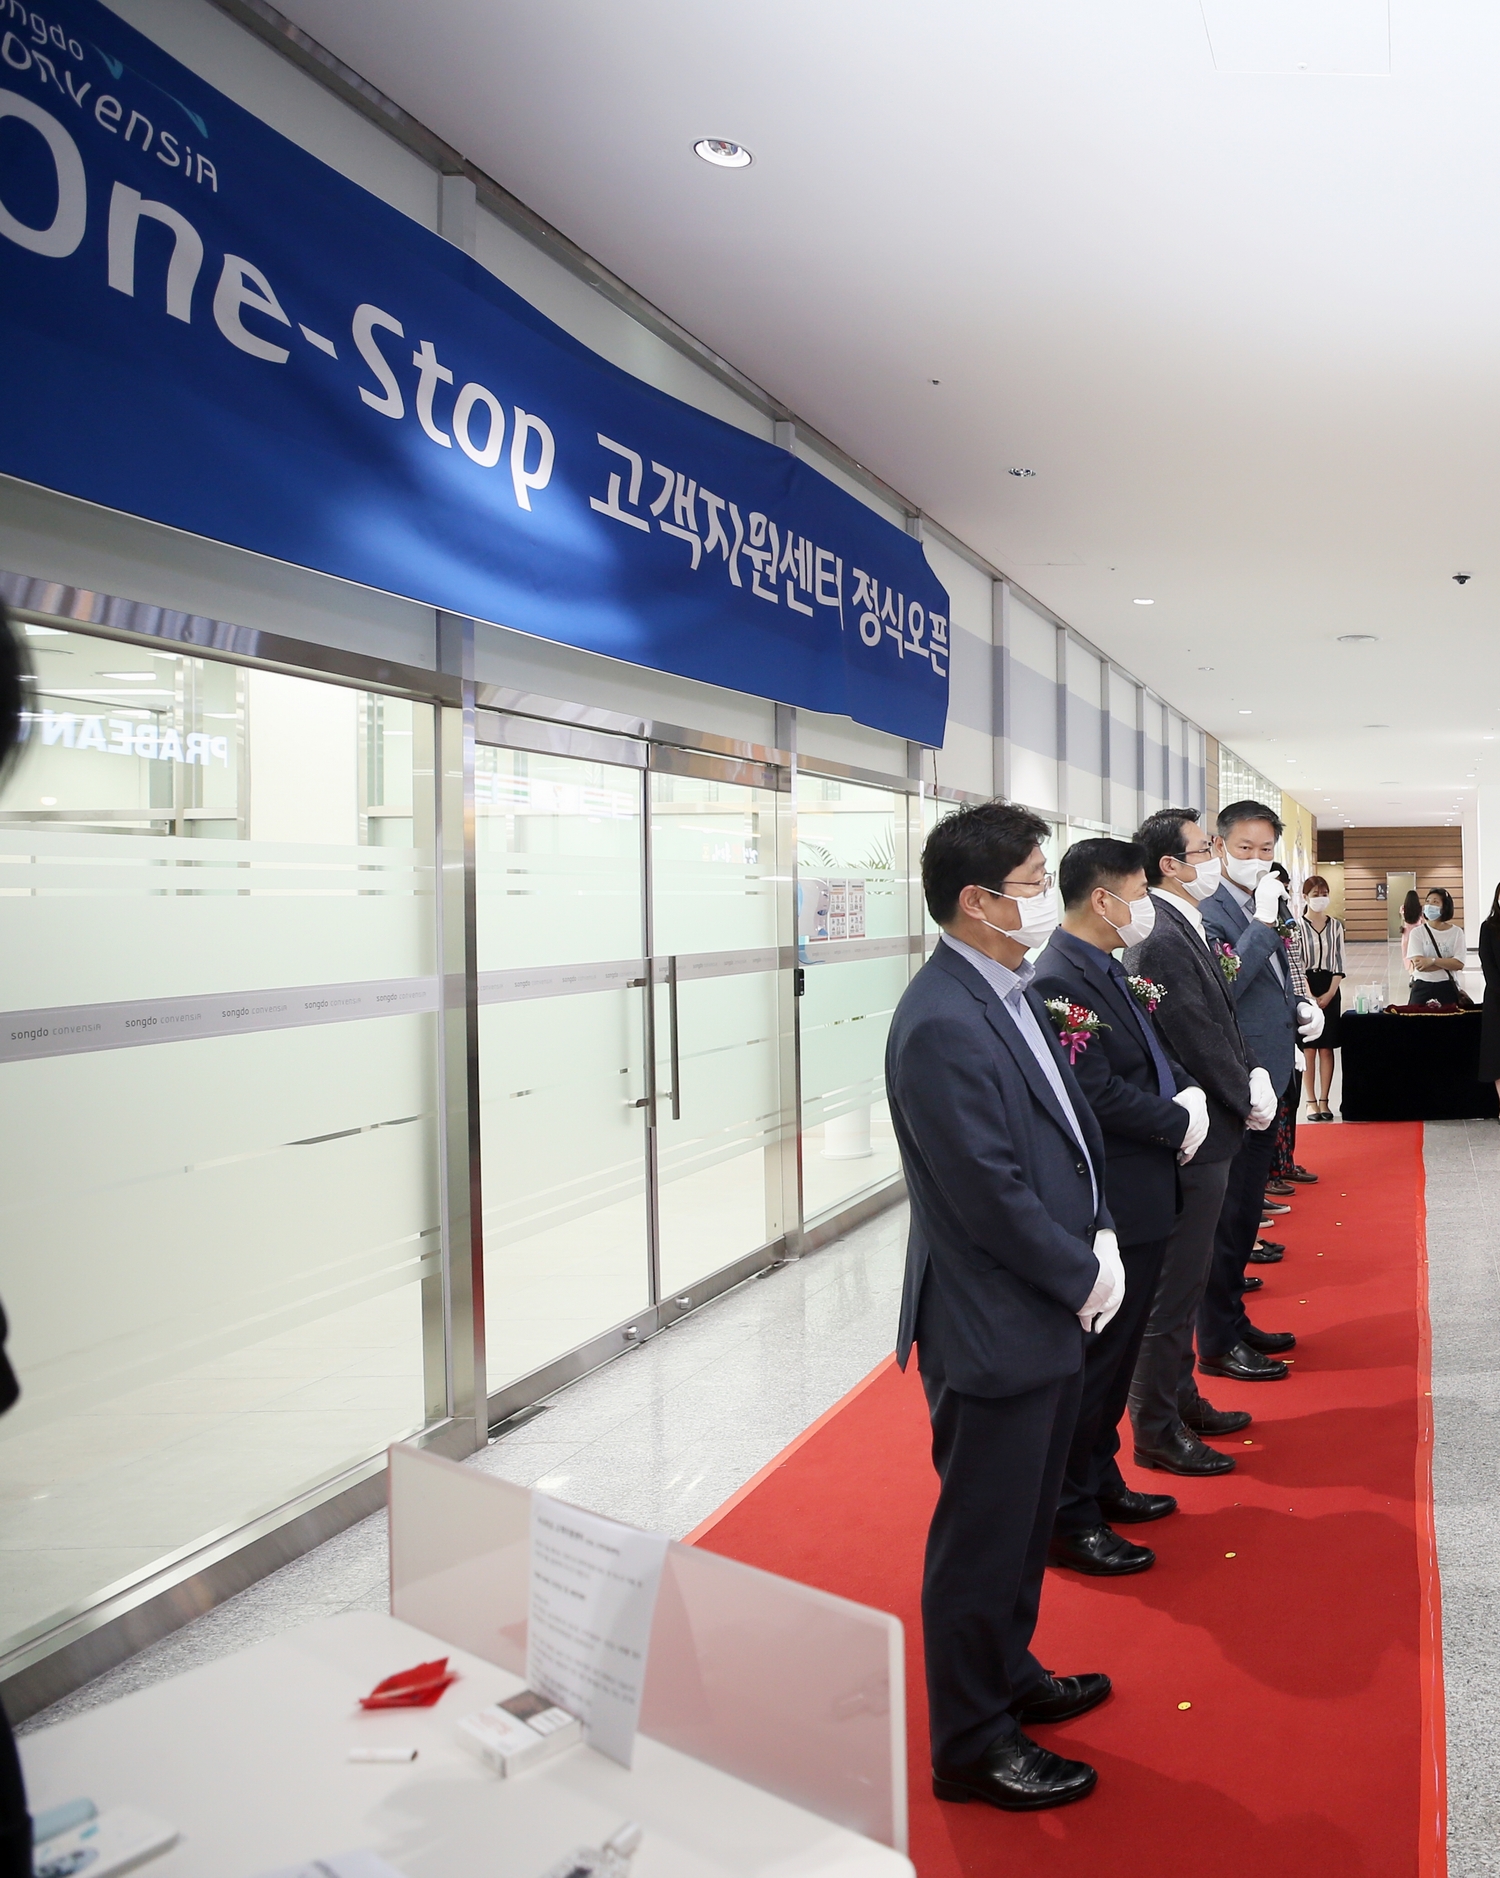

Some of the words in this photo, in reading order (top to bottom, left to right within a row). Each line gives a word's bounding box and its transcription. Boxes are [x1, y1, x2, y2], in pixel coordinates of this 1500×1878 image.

[0, 0, 84, 61] ngdo
[589, 432, 844, 631] 고객지원센터
[852, 567, 949, 678] 정식오픈
[376, 993, 398, 1003] songdo
[304, 1000, 329, 1011] songdo
[222, 1007, 250, 1019] songdo
[125, 1016, 158, 1028] songdo
[11, 1027, 49, 1041] songdo
